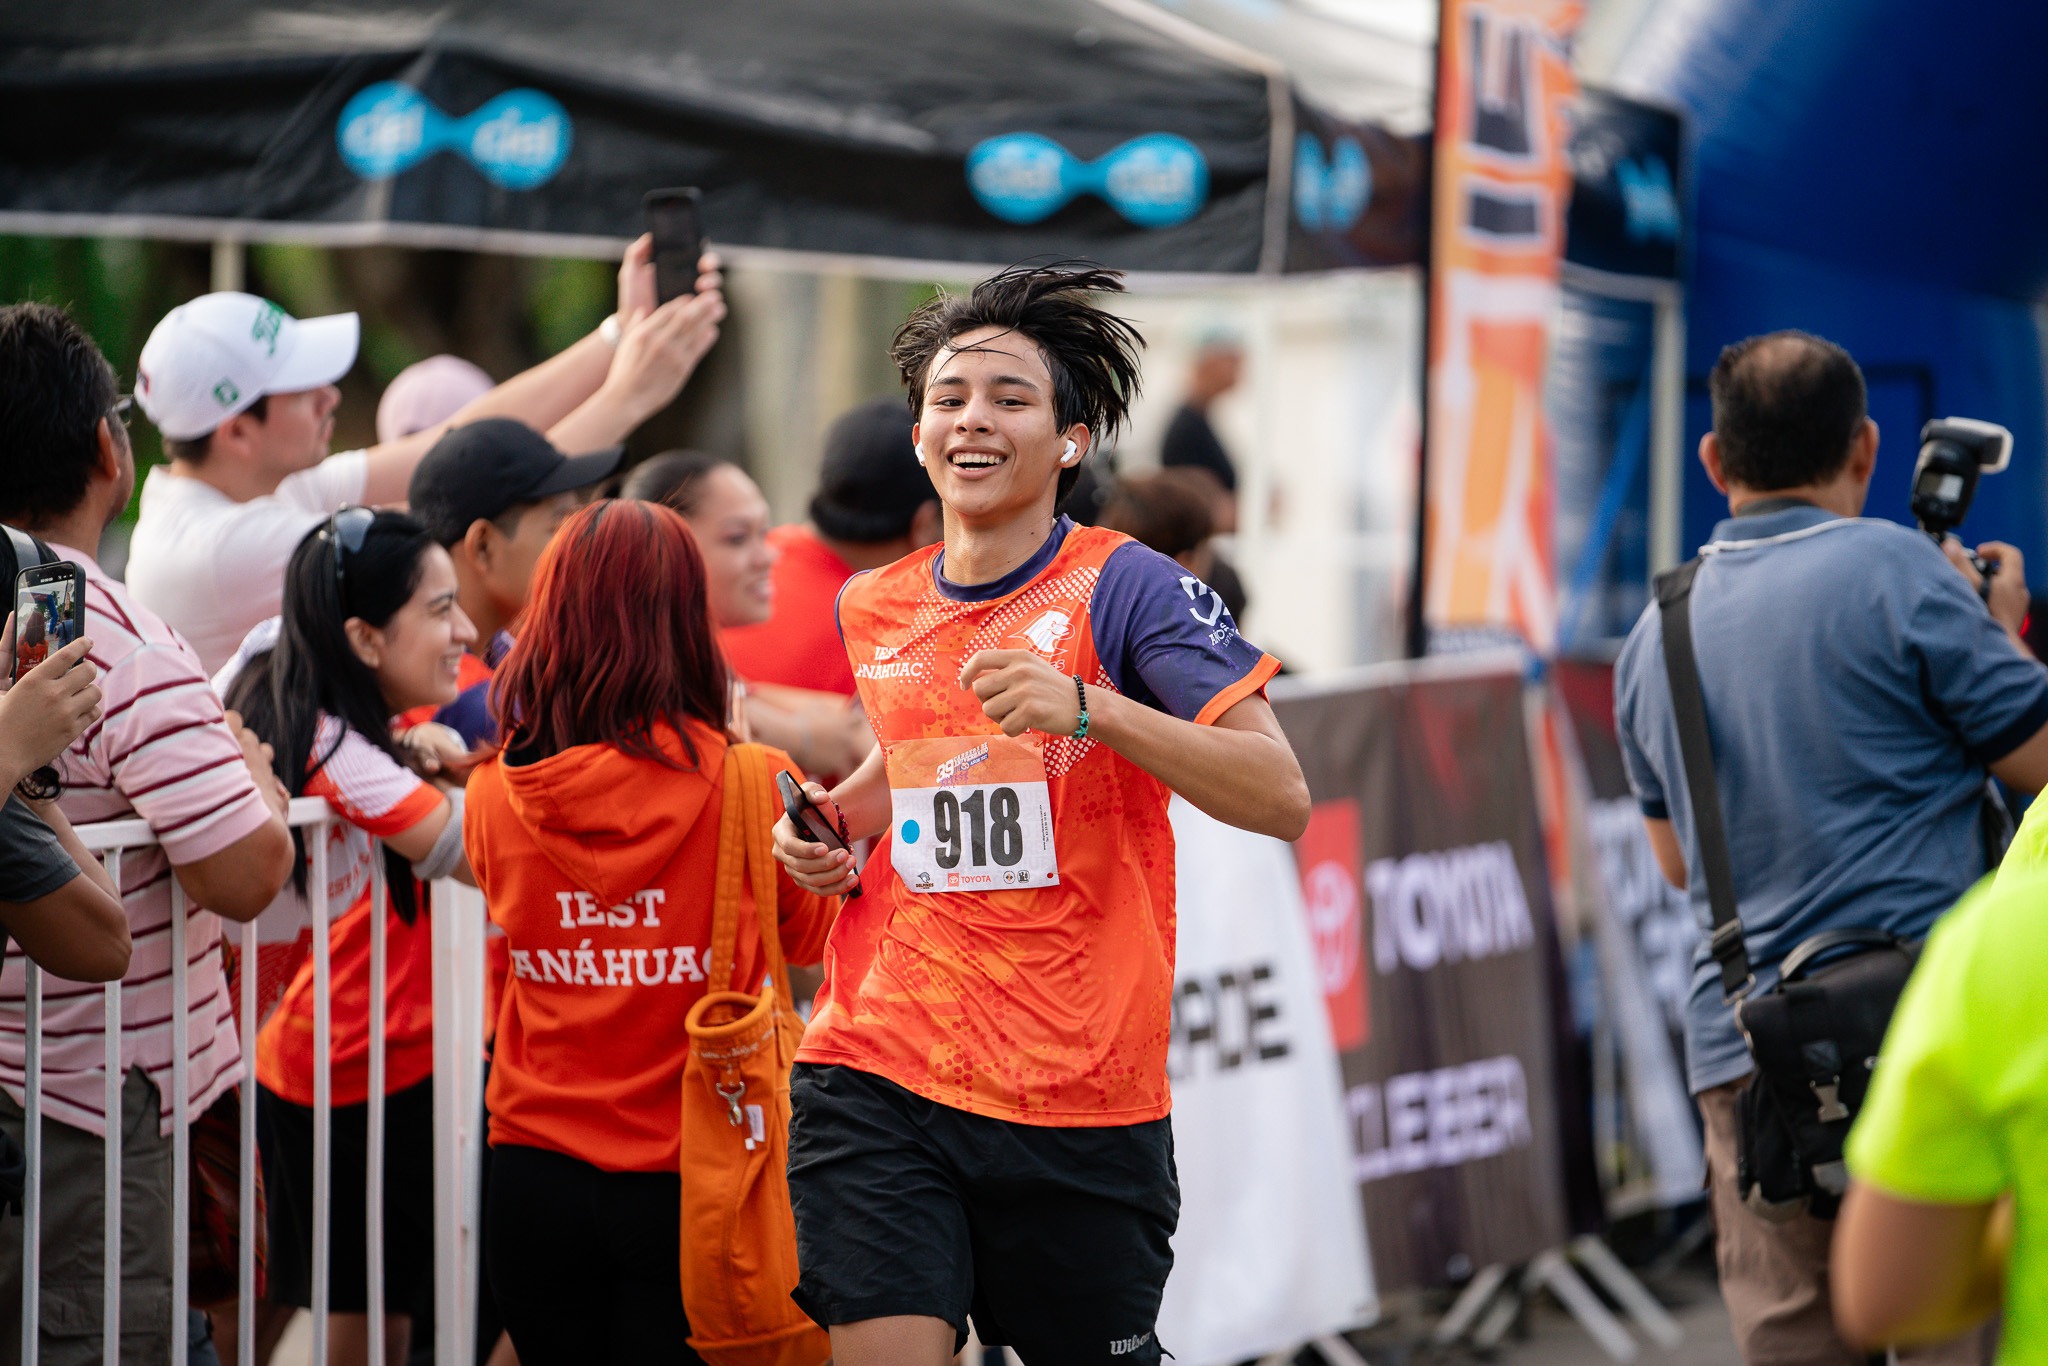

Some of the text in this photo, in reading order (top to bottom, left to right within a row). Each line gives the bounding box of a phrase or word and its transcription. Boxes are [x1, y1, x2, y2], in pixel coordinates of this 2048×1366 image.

[933, 786, 1023, 869] 918
[961, 875, 992, 883] TOYOTA
[556, 889, 665, 928] IEST
[511, 938, 735, 986] ANÁHUA
